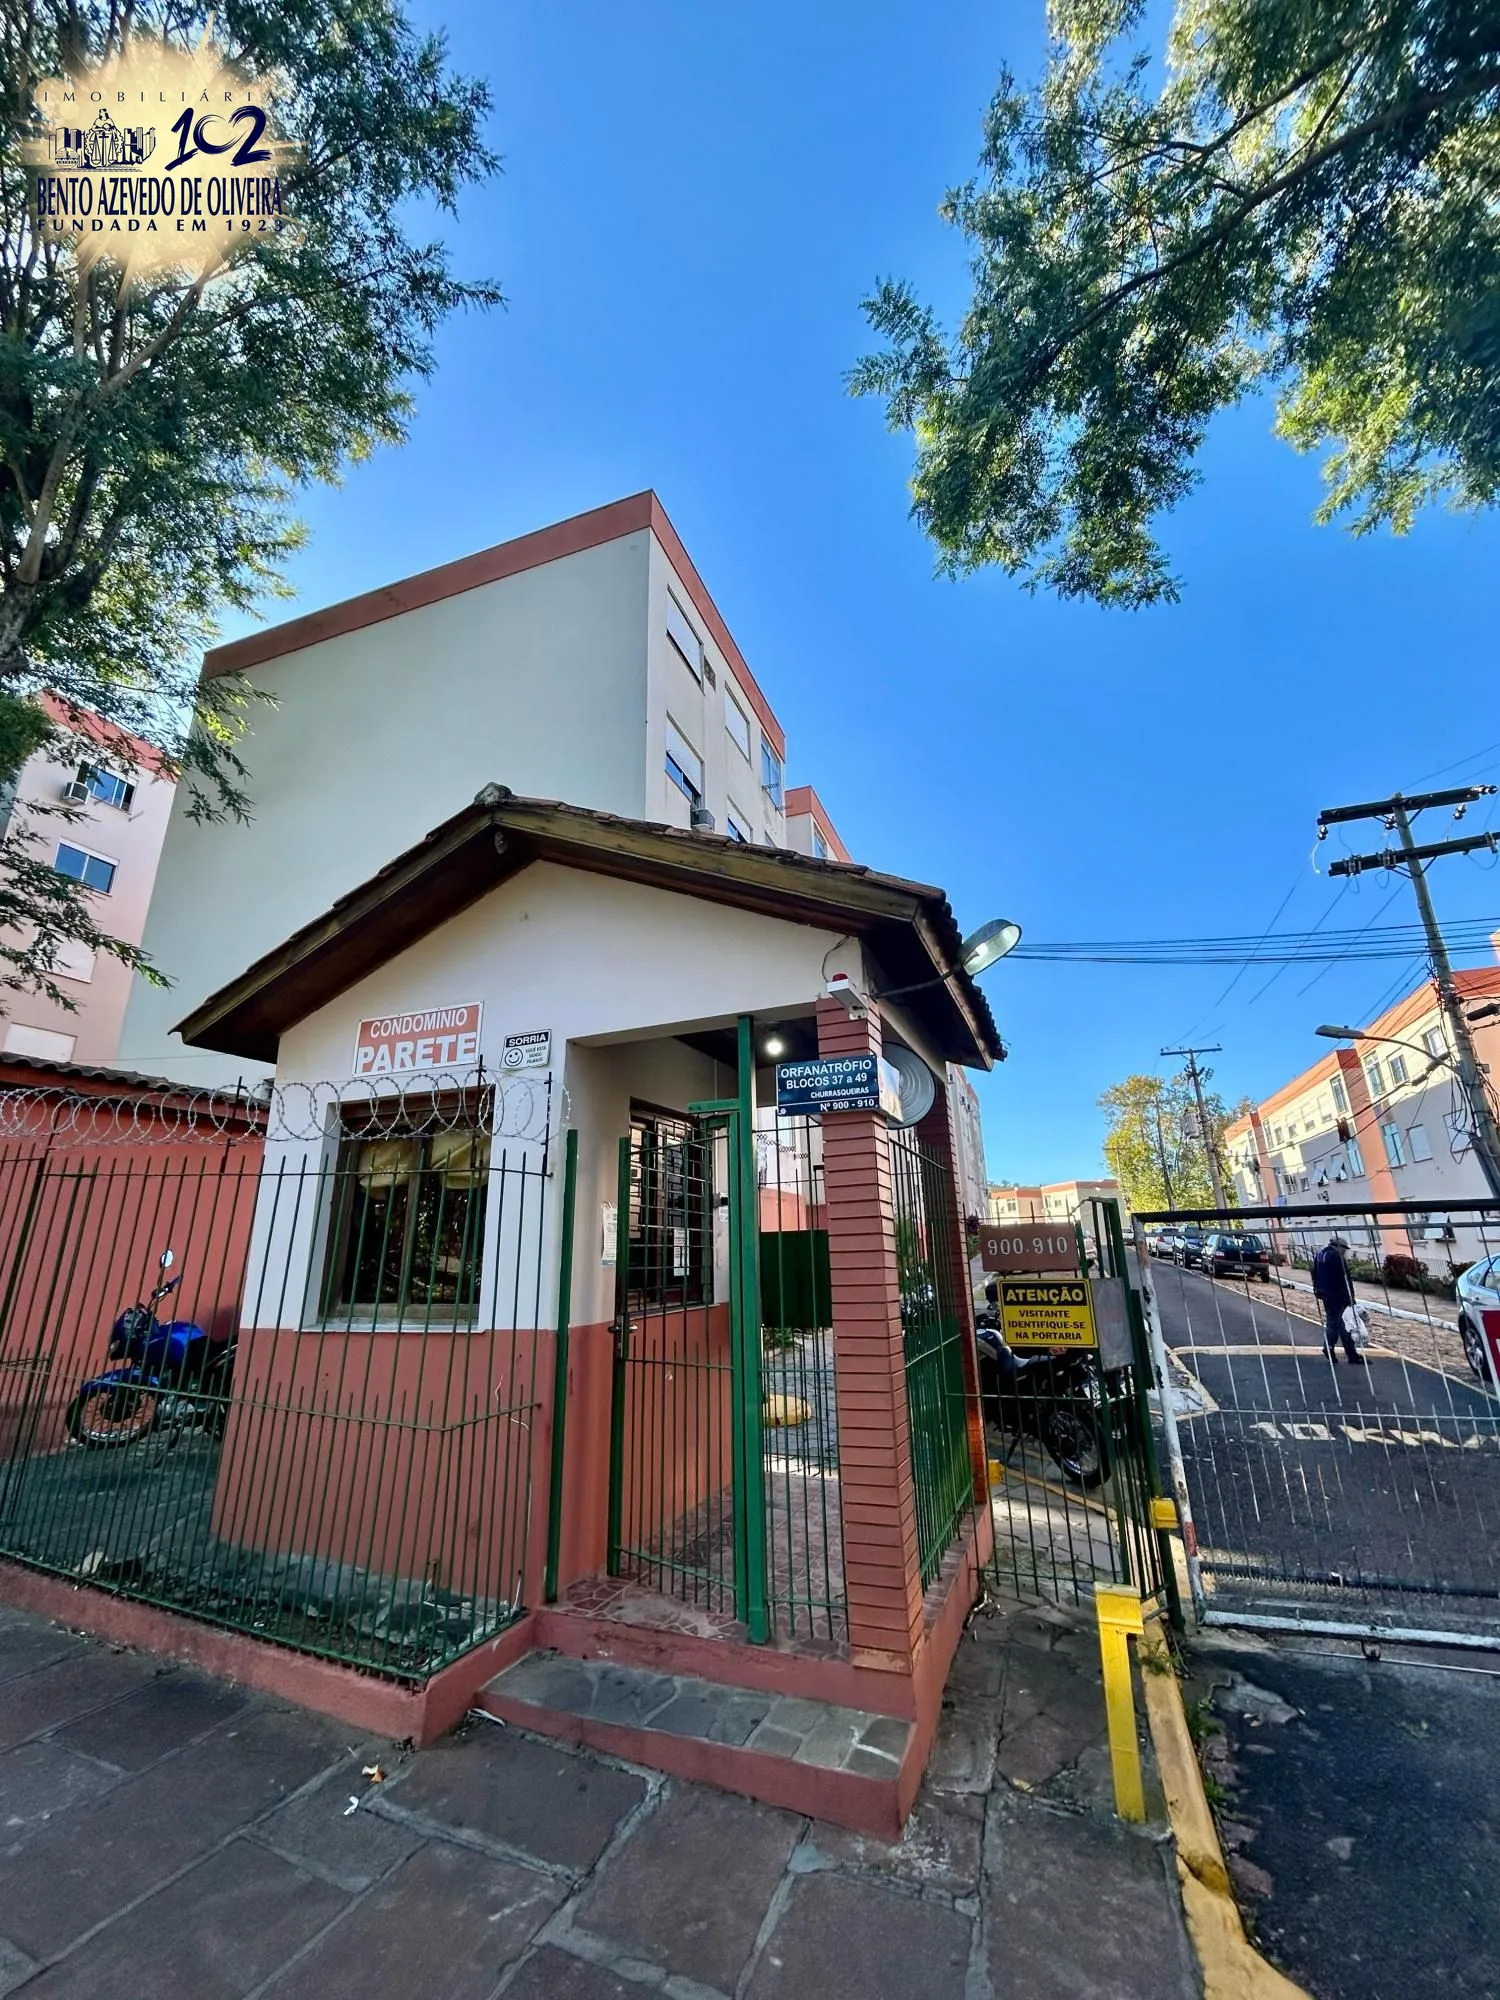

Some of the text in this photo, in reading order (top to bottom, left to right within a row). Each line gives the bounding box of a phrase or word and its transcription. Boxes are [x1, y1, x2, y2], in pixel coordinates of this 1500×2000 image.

[508, 1033, 547, 1047] SORRIA
[357, 1031, 477, 1074] PARETE
[780, 1059, 872, 1079] ORFANATRÓFIO
[786, 1077, 830, 1090] BLOCOS
[832, 1075, 844, 1085] 37
[855, 1072, 868, 1083] 49
[810, 1086, 870, 1099] CHURRASQUEIRAS
[832, 1101, 849, 1110] 900
[1005, 1287, 1084, 1304] ATENÇÃO
[1018, 1310, 1070, 1318] VISITANTE
[1008, 1320, 1086, 1329] IDENTIFIQUE-SE
[1015, 1331, 1082, 1340] NA PORTARIA
[1249, 1421, 1336, 1440] 10
